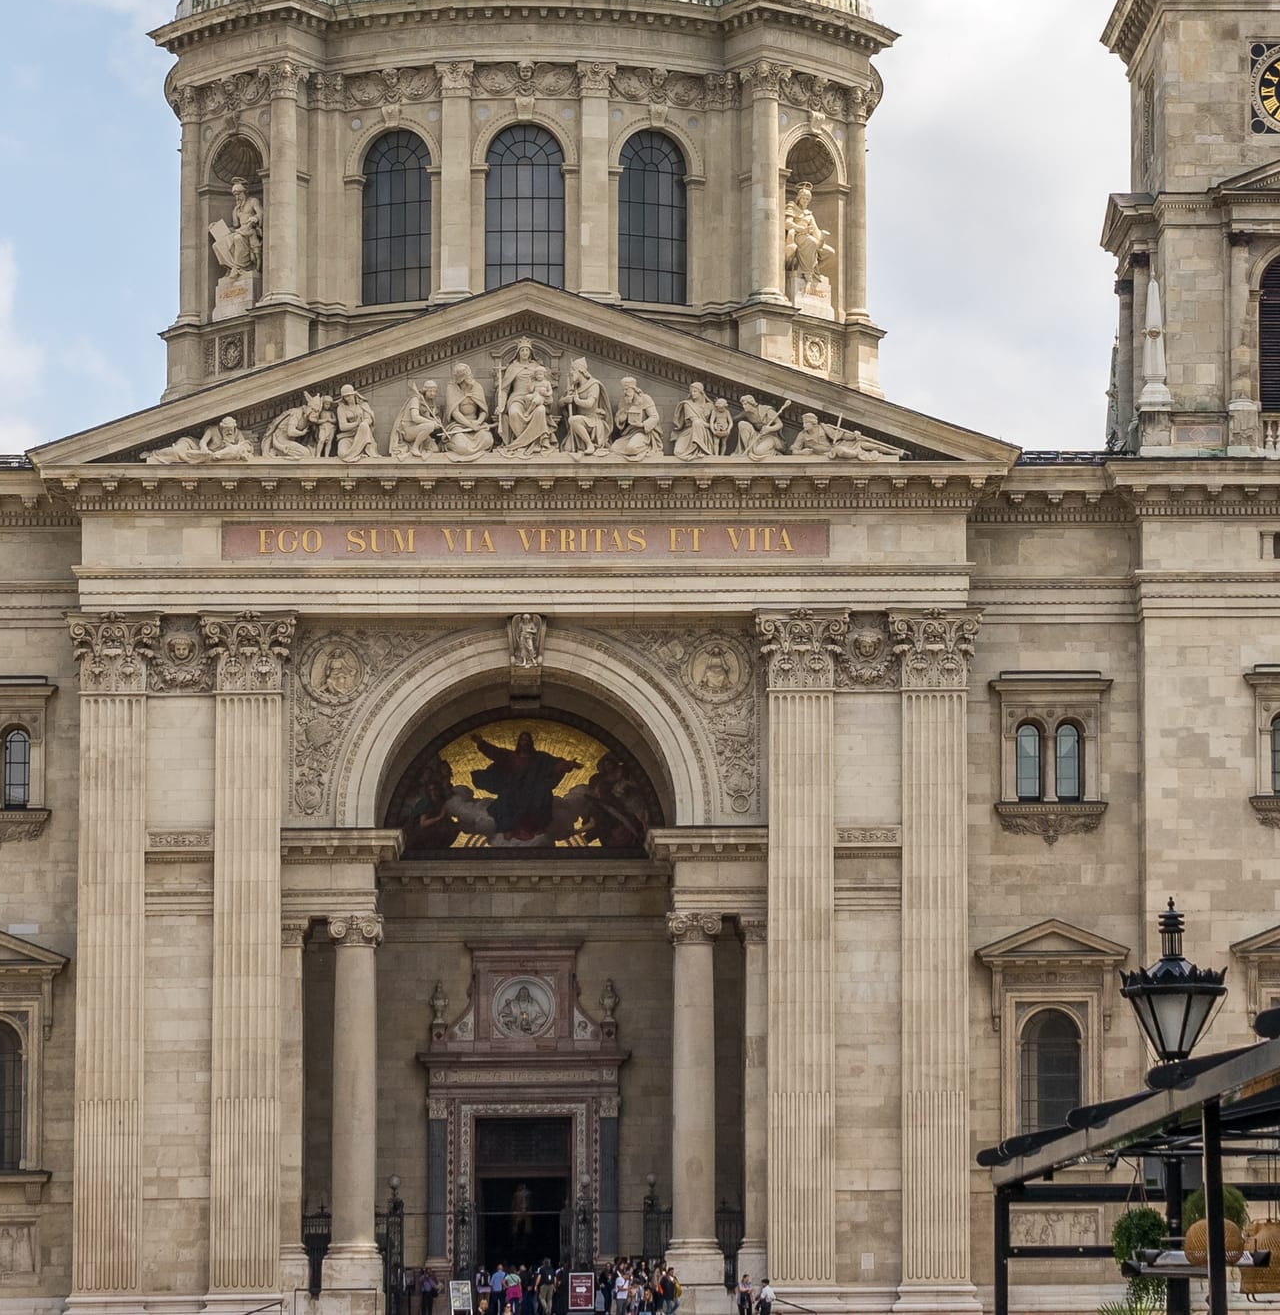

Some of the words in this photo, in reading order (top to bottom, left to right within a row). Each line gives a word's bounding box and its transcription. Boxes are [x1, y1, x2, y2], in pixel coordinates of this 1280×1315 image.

[1264, 71, 1279, 84] X
[258, 529, 324, 554] EGO
[346, 528, 416, 554] SUM
[441, 528, 497, 554] VIA
[516, 527, 648, 553] VERITAS
[669, 527, 706, 553] ET
[727, 527, 795, 553] VITA
